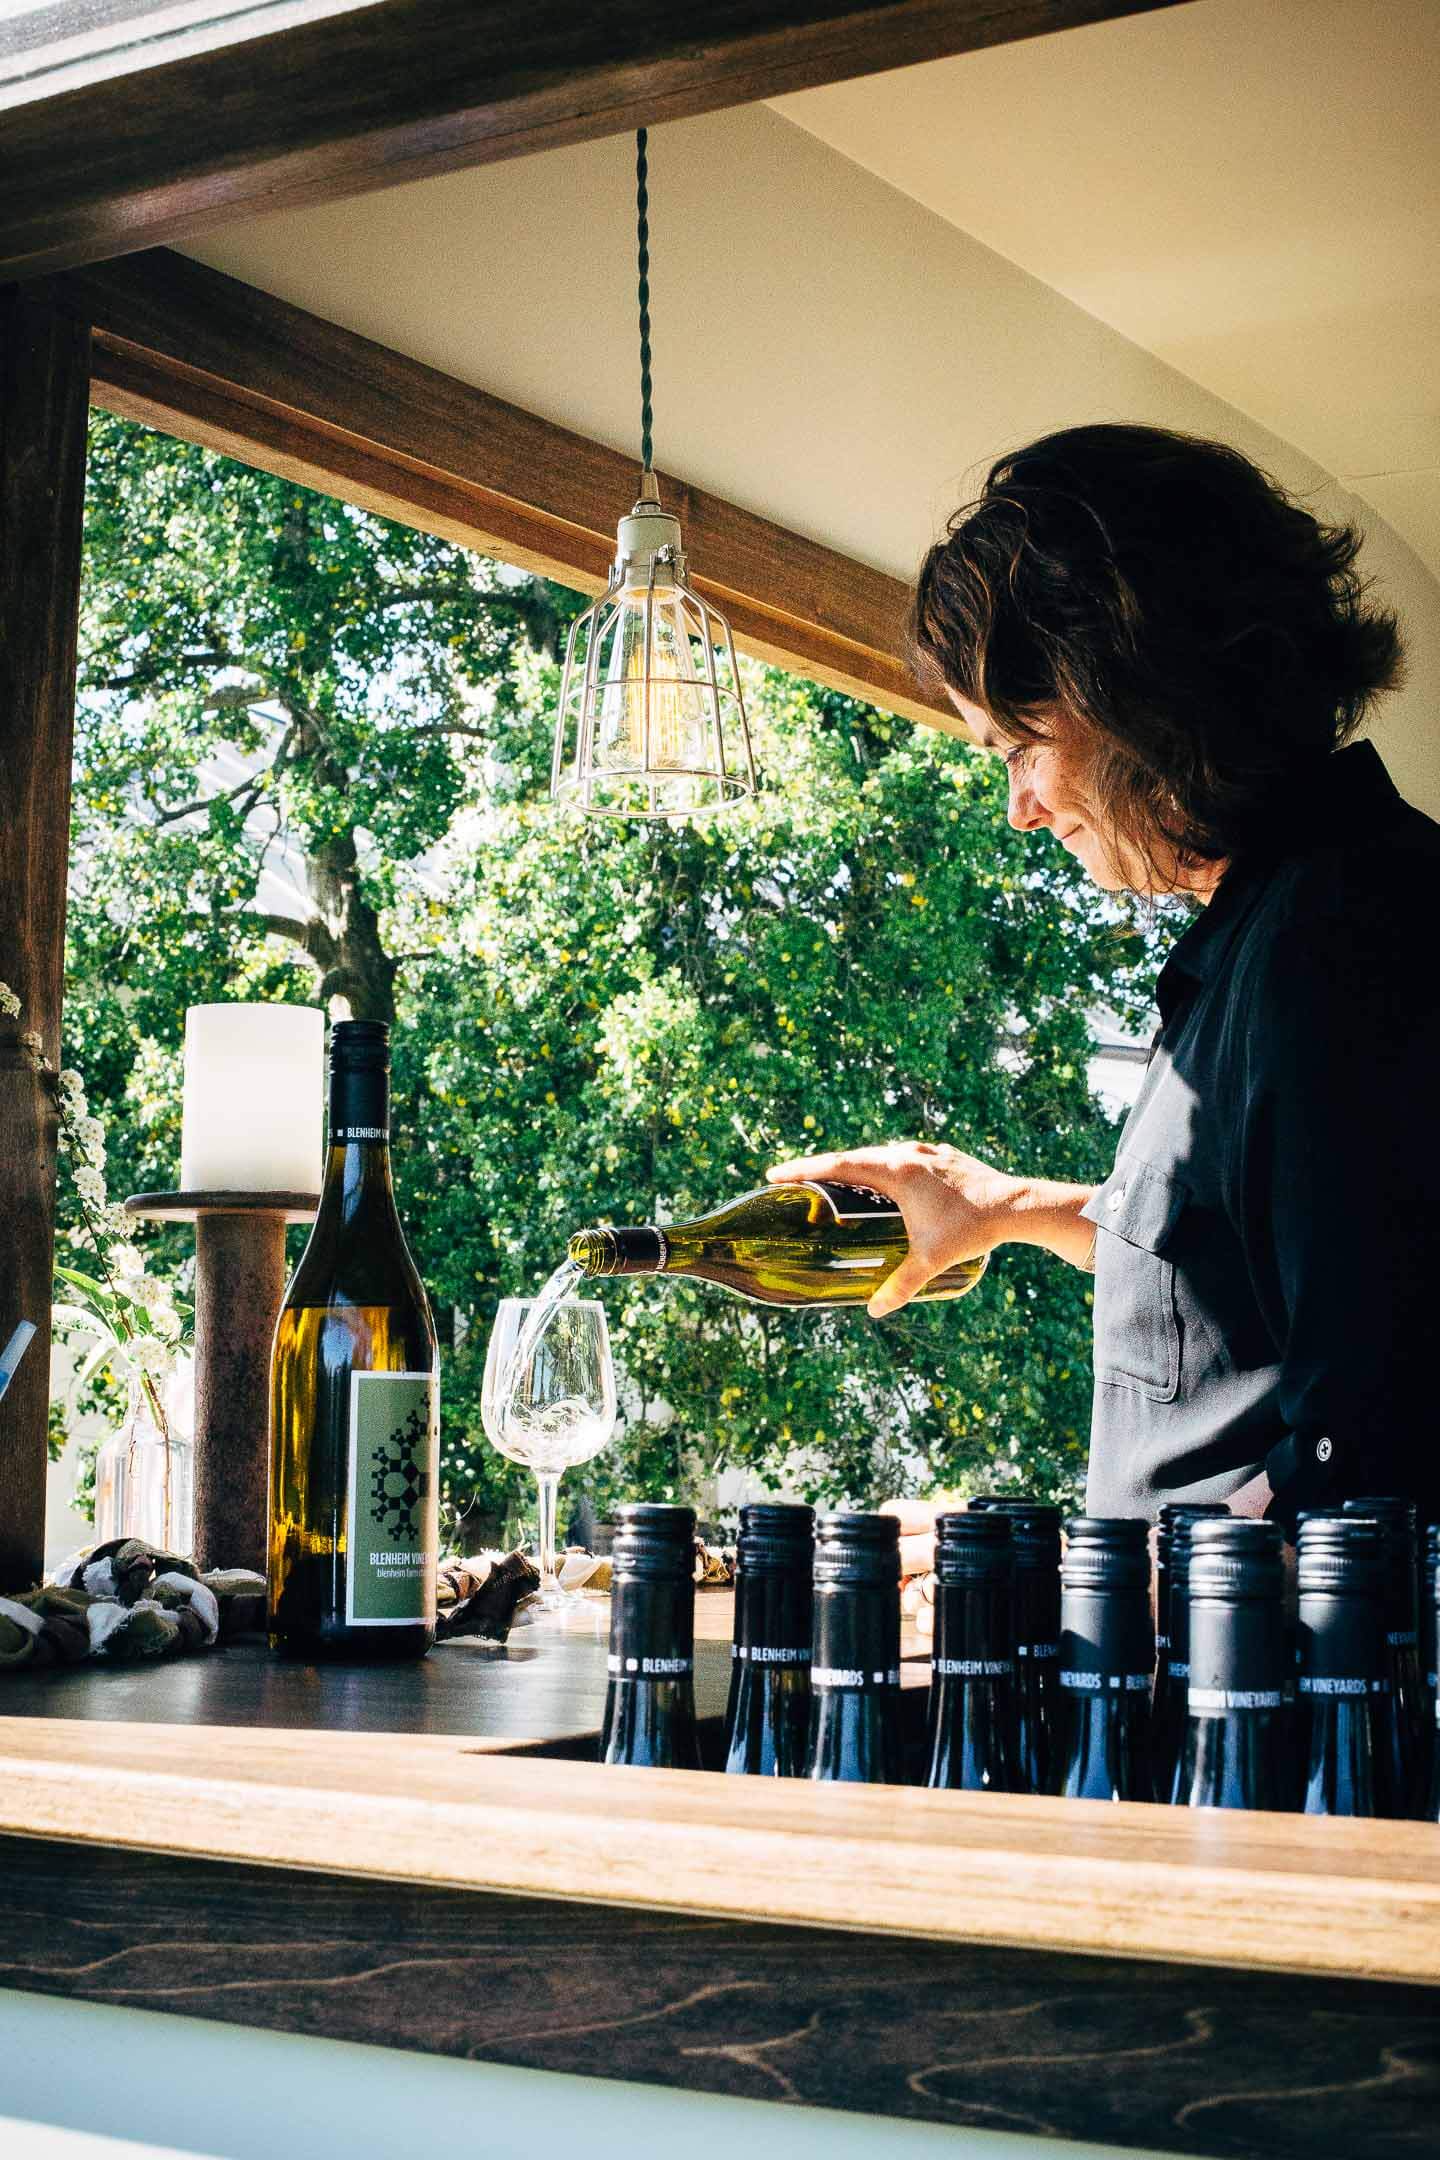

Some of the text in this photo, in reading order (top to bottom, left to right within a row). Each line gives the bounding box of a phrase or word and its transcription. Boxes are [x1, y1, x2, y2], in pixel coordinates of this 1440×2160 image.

[347, 1127, 381, 1138] BLENHEIM
[369, 1552, 410, 1565] BLENHEIM
[751, 1645, 798, 1662] BLENHEIM
[937, 1658, 983, 1675] BLENHEIM
[1310, 1677, 1367, 1695] VINEYARDS
